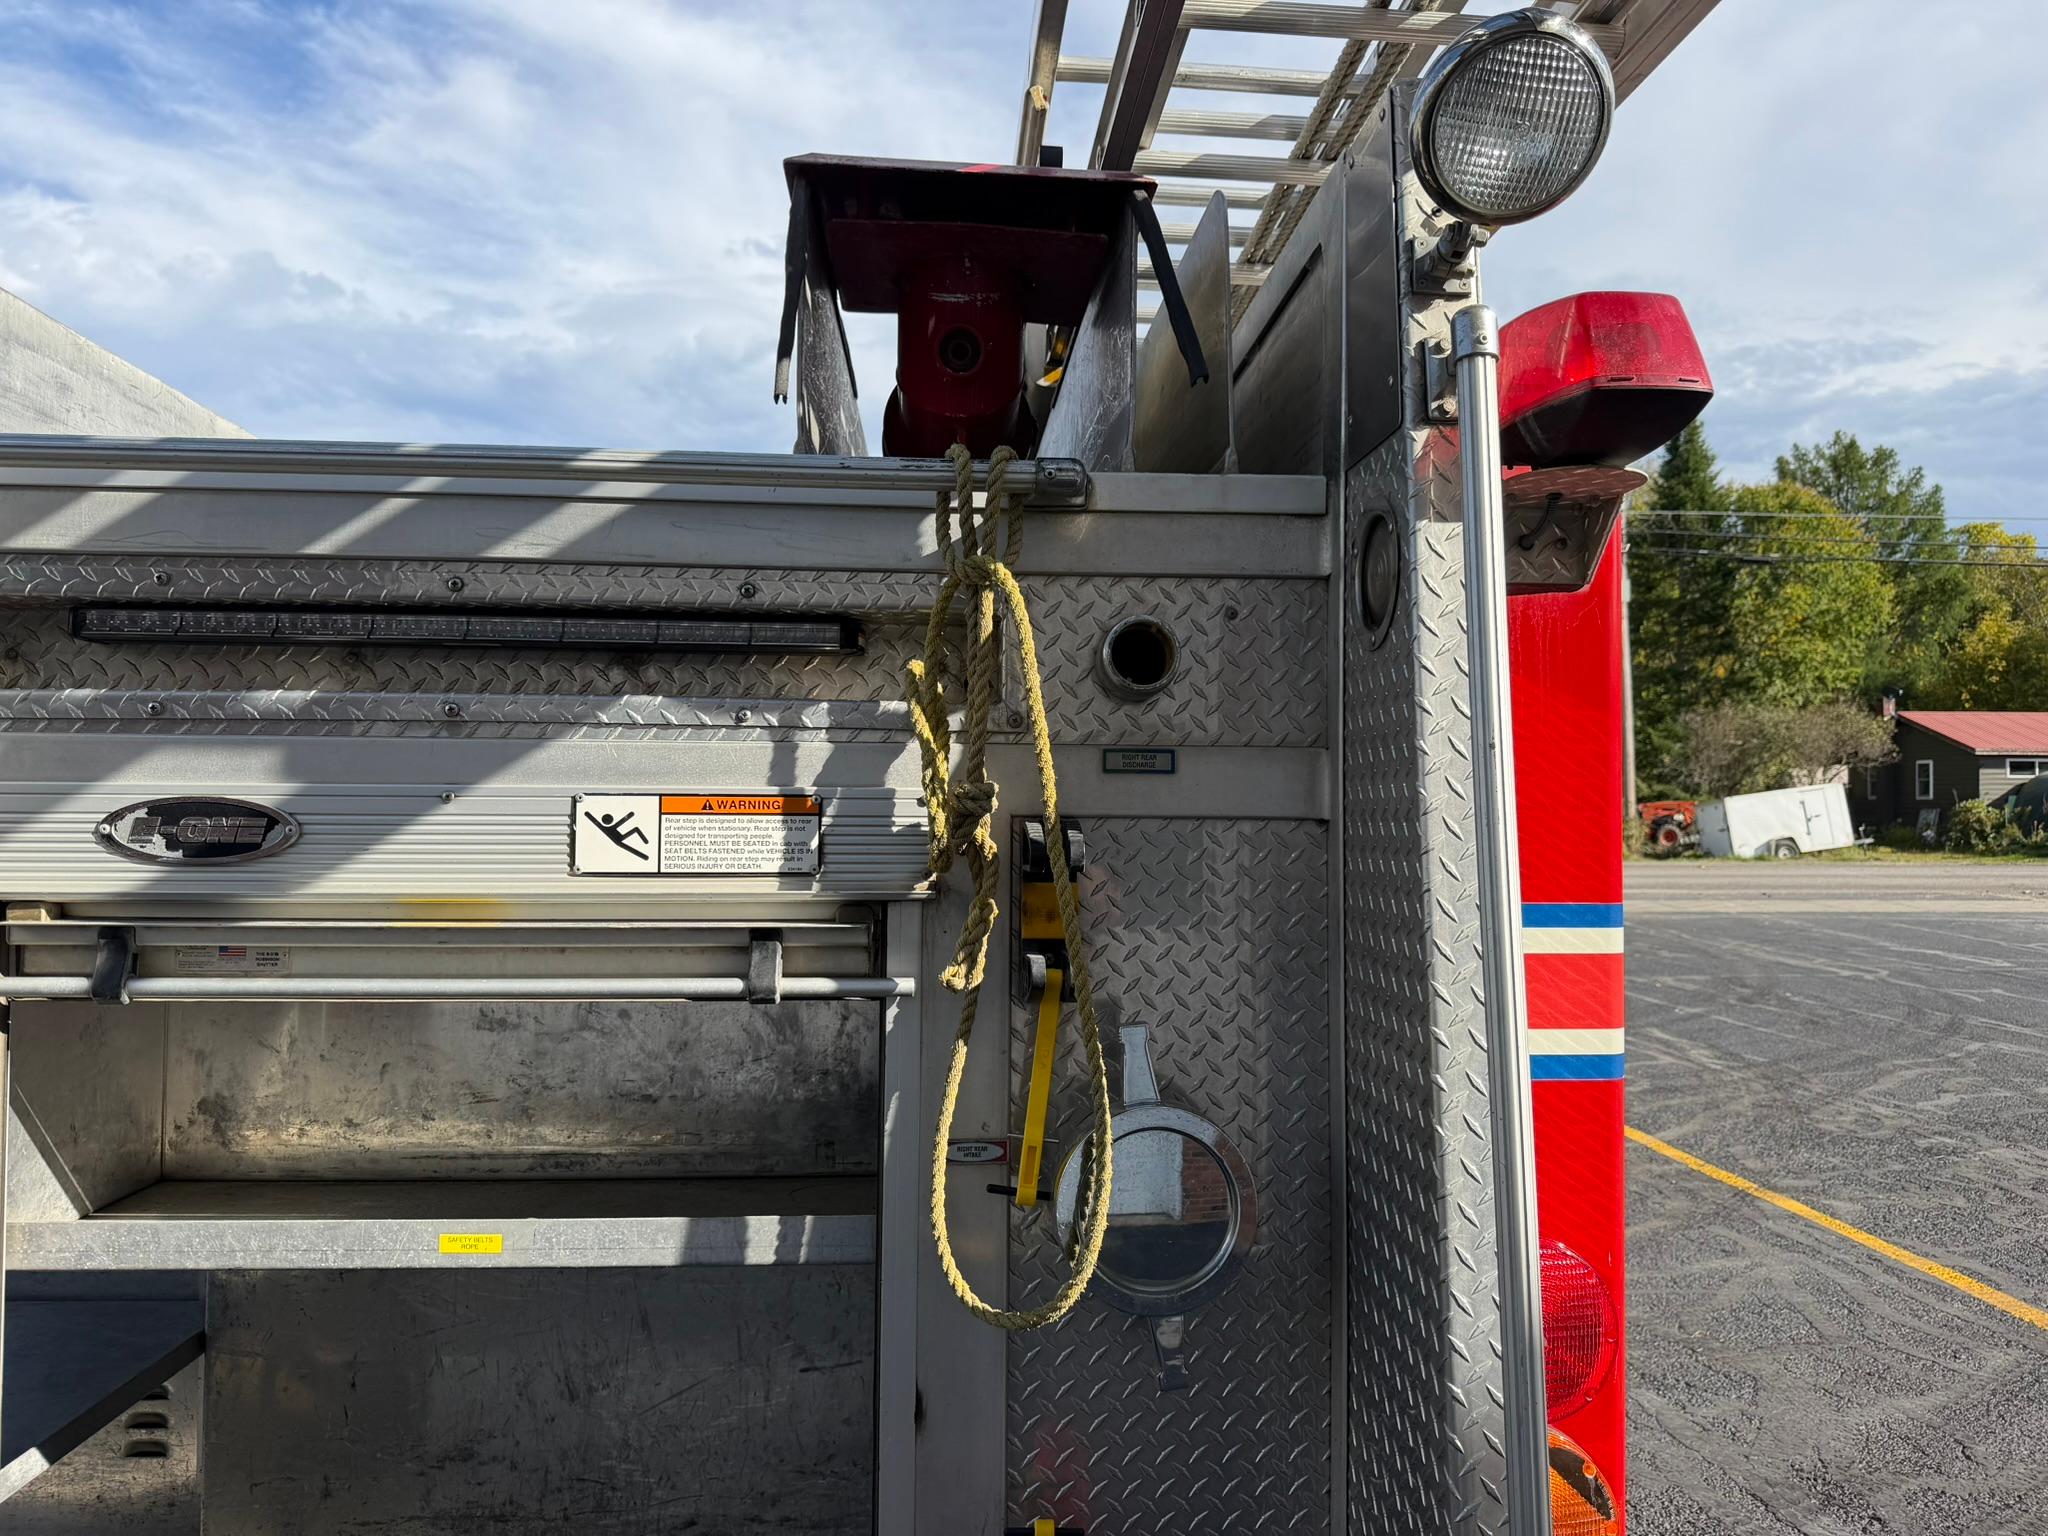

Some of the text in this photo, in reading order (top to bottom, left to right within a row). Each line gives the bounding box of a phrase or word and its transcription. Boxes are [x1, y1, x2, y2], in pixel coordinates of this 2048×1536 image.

[717, 800, 781, 810] WARNING
[683, 817, 697, 825] step
[706, 817, 737, 825] designed
[126, 816, 268, 844] E-ONE
